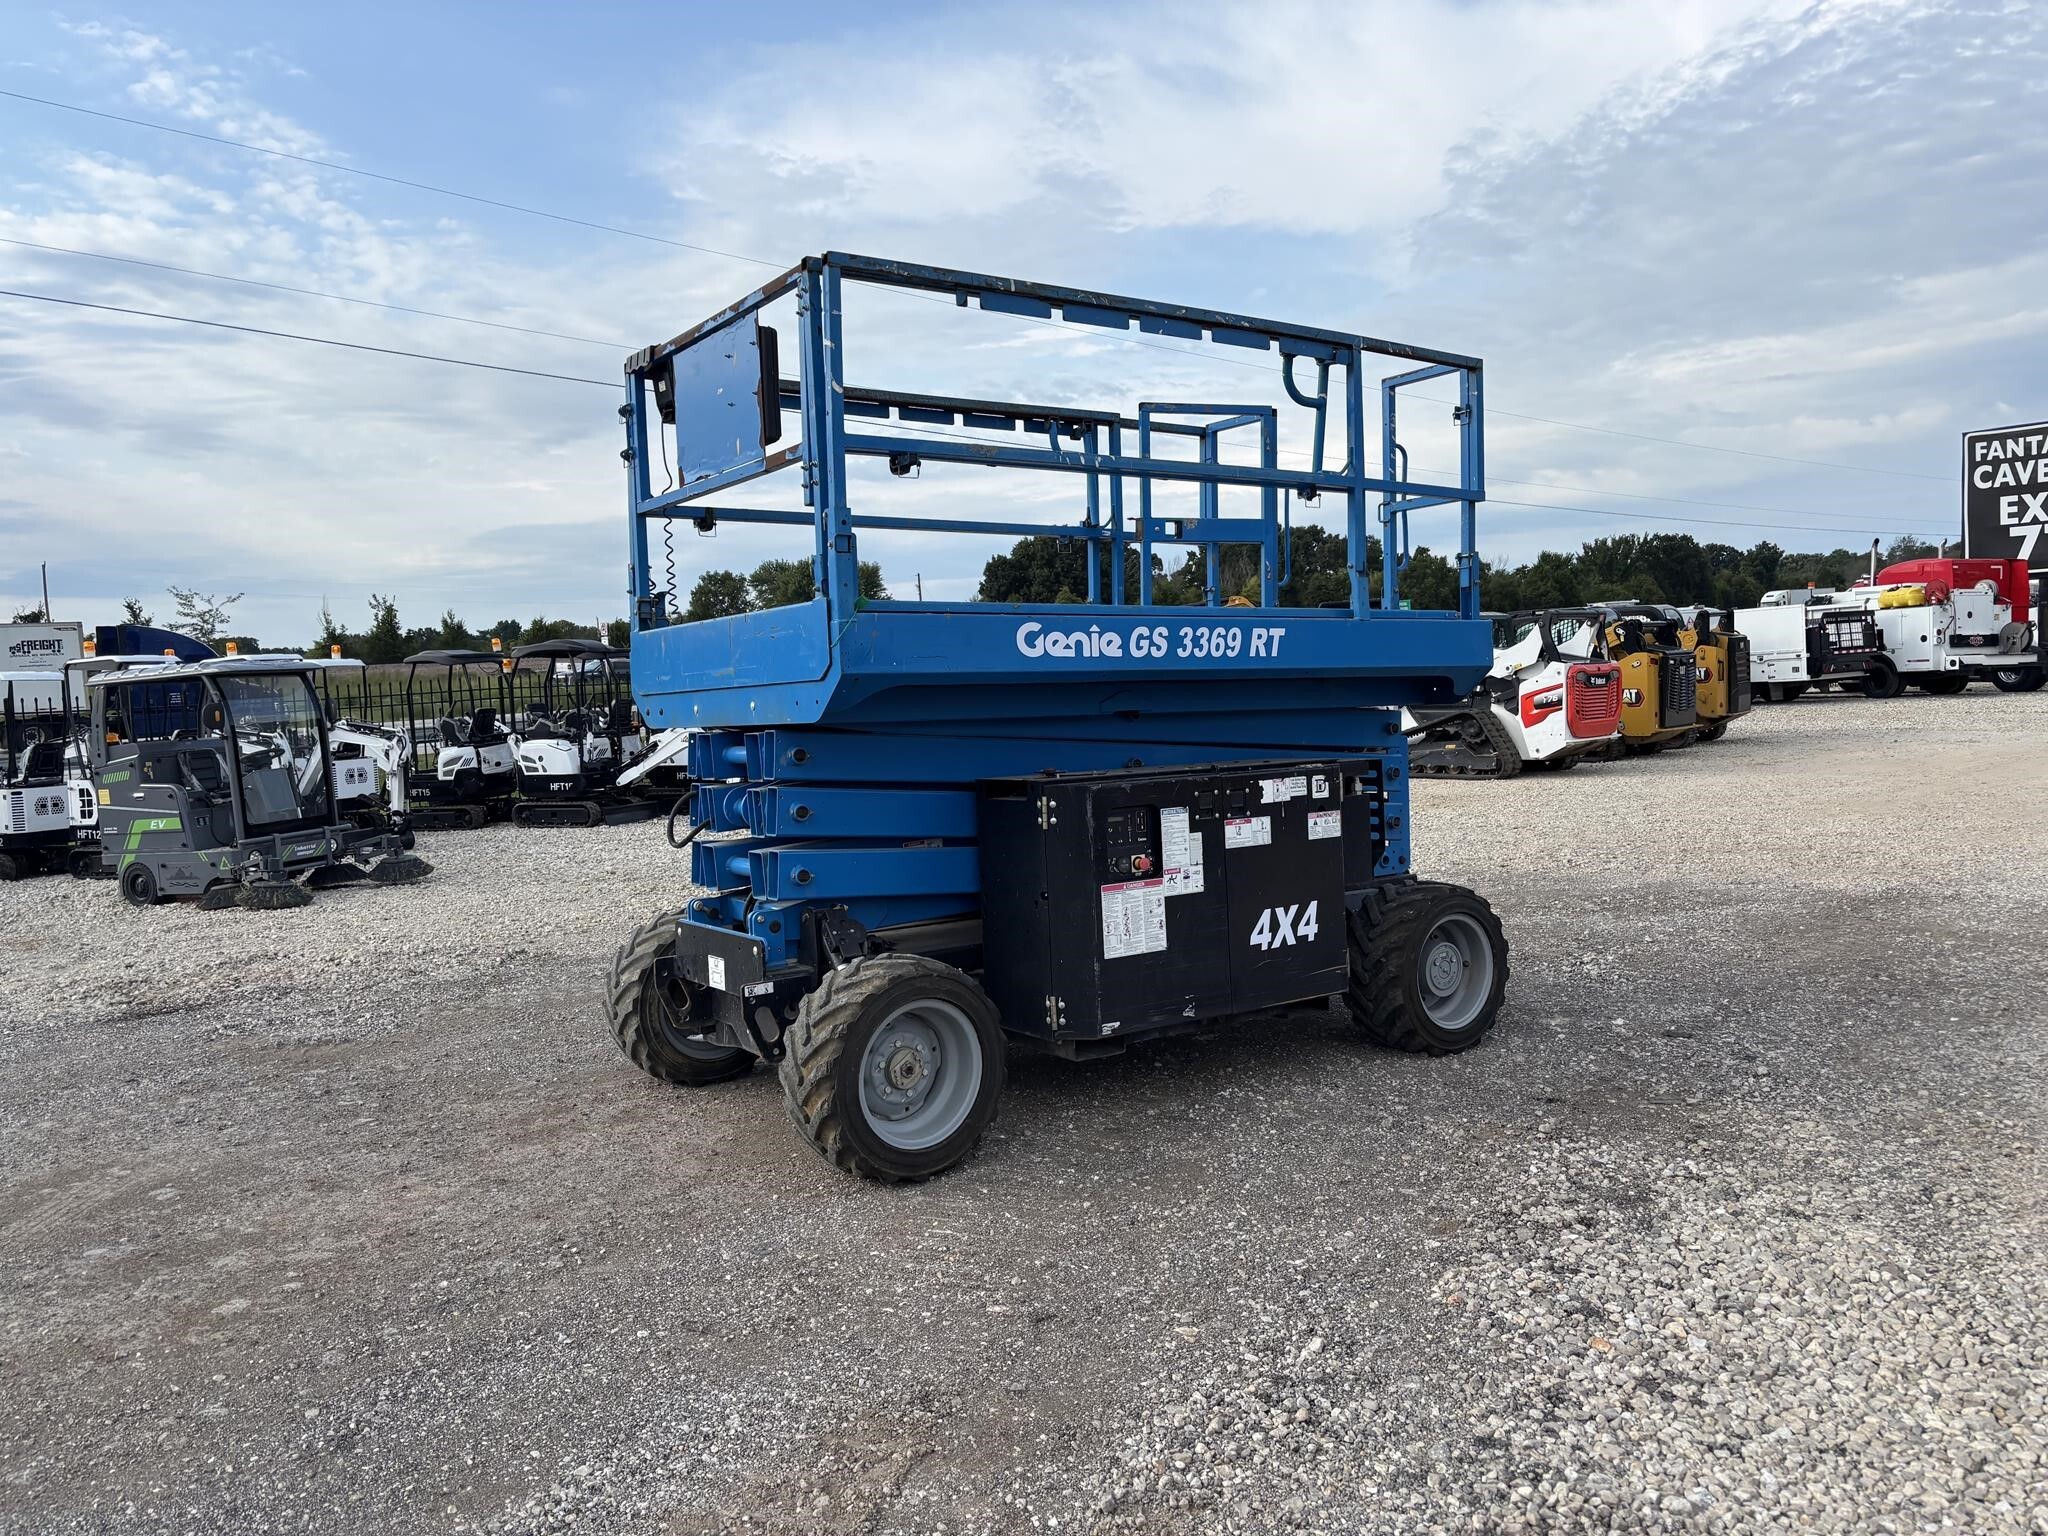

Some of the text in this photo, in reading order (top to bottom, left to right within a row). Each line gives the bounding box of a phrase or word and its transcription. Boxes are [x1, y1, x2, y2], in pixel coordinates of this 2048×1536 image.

[2009, 523, 2048, 560] 7
[20, 639, 63, 651] FREIGHT
[1016, 621, 1286, 658] Genie GS 3369 RT
[1542, 695, 1558, 704] T76
[1622, 688, 1638, 704] AT
[676, 772, 698, 780] HFT
[150, 820, 166, 829] EV
[77, 829, 102, 840] HFT12
[1249, 900, 1319, 951] 4X4
